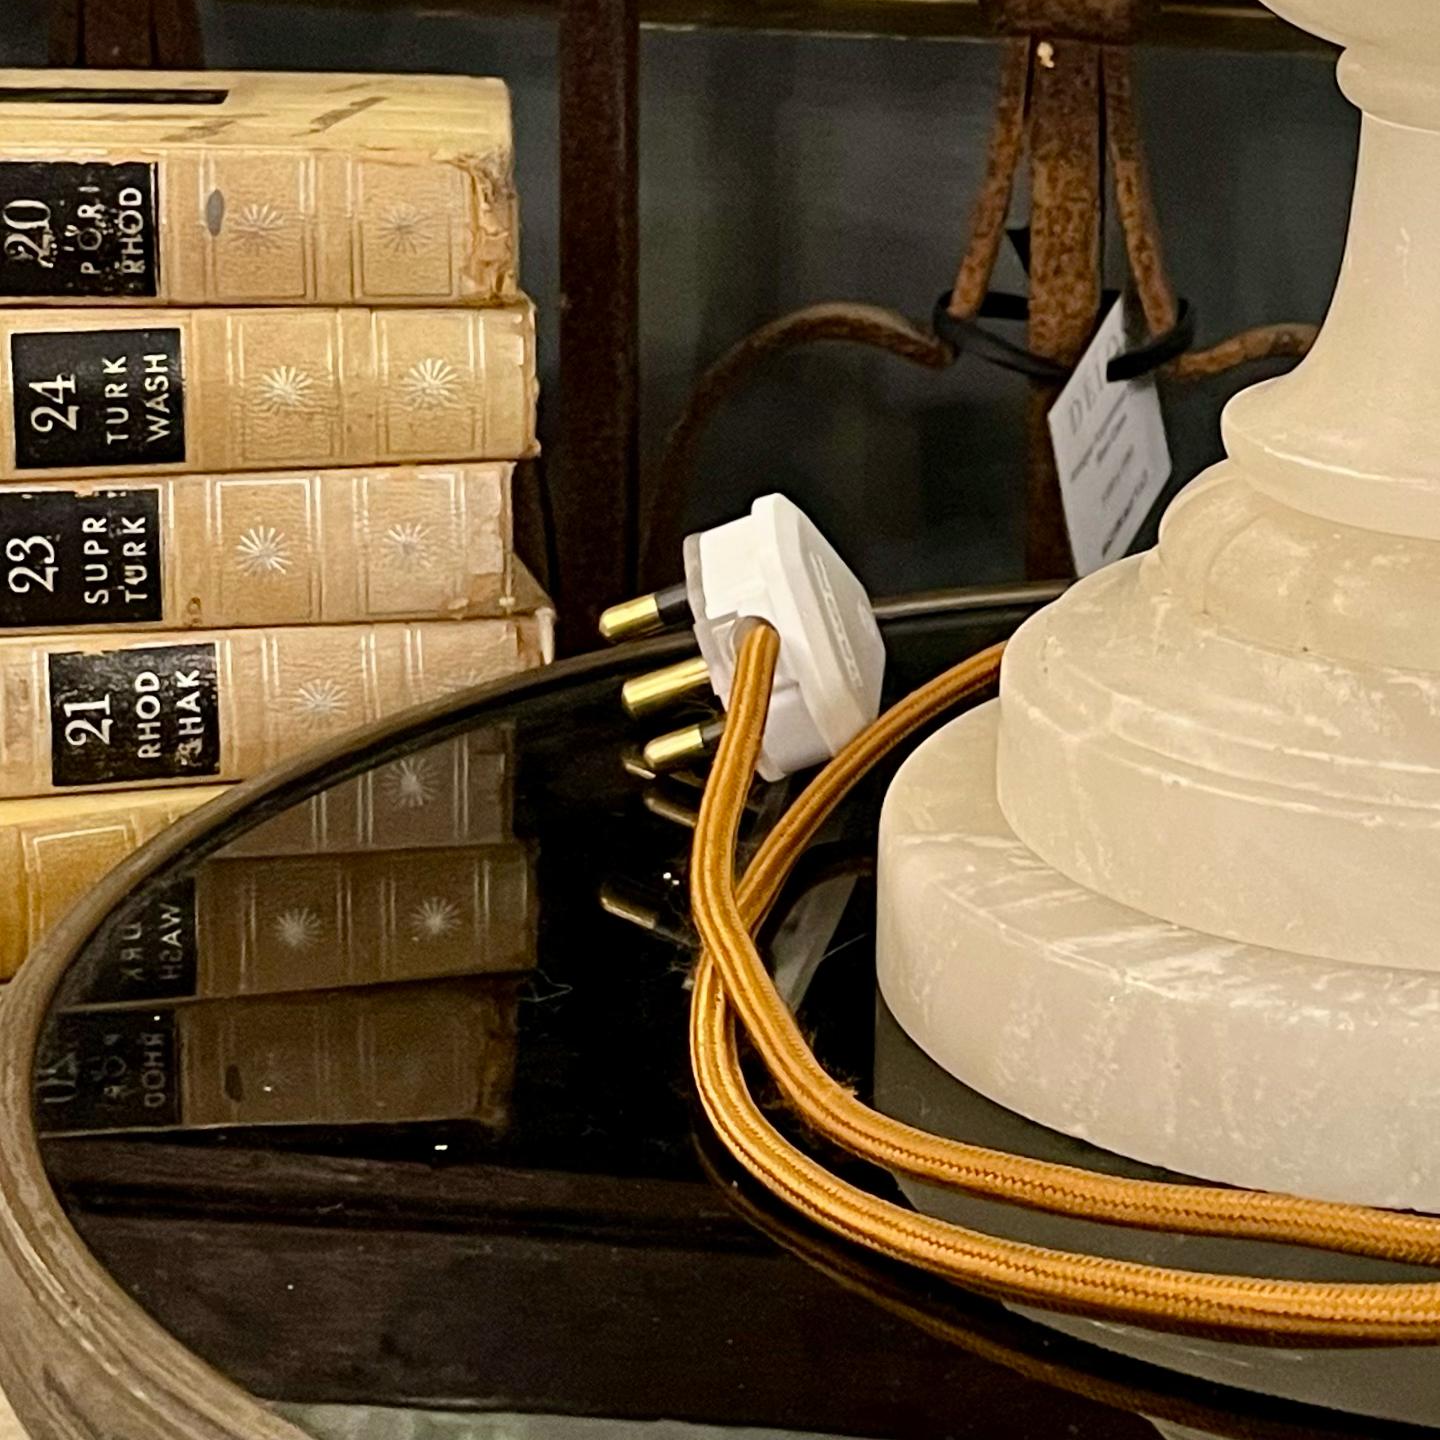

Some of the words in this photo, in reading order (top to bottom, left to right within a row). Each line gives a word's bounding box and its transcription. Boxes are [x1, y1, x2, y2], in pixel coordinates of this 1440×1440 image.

[3, 199, 54, 268] 20
[117, 187, 146, 274] RHOD
[29, 373, 79, 432] 24
[102, 356, 129, 445] TURK
[142, 353, 170, 442] WASH
[6, 535, 59, 593] 23
[82, 517, 109, 604] SUPR
[121, 517, 148, 603] TURK
[63, 694, 113, 746] 21
[135, 671, 161, 759] RHOD
[175, 670, 204, 765] SHAK
